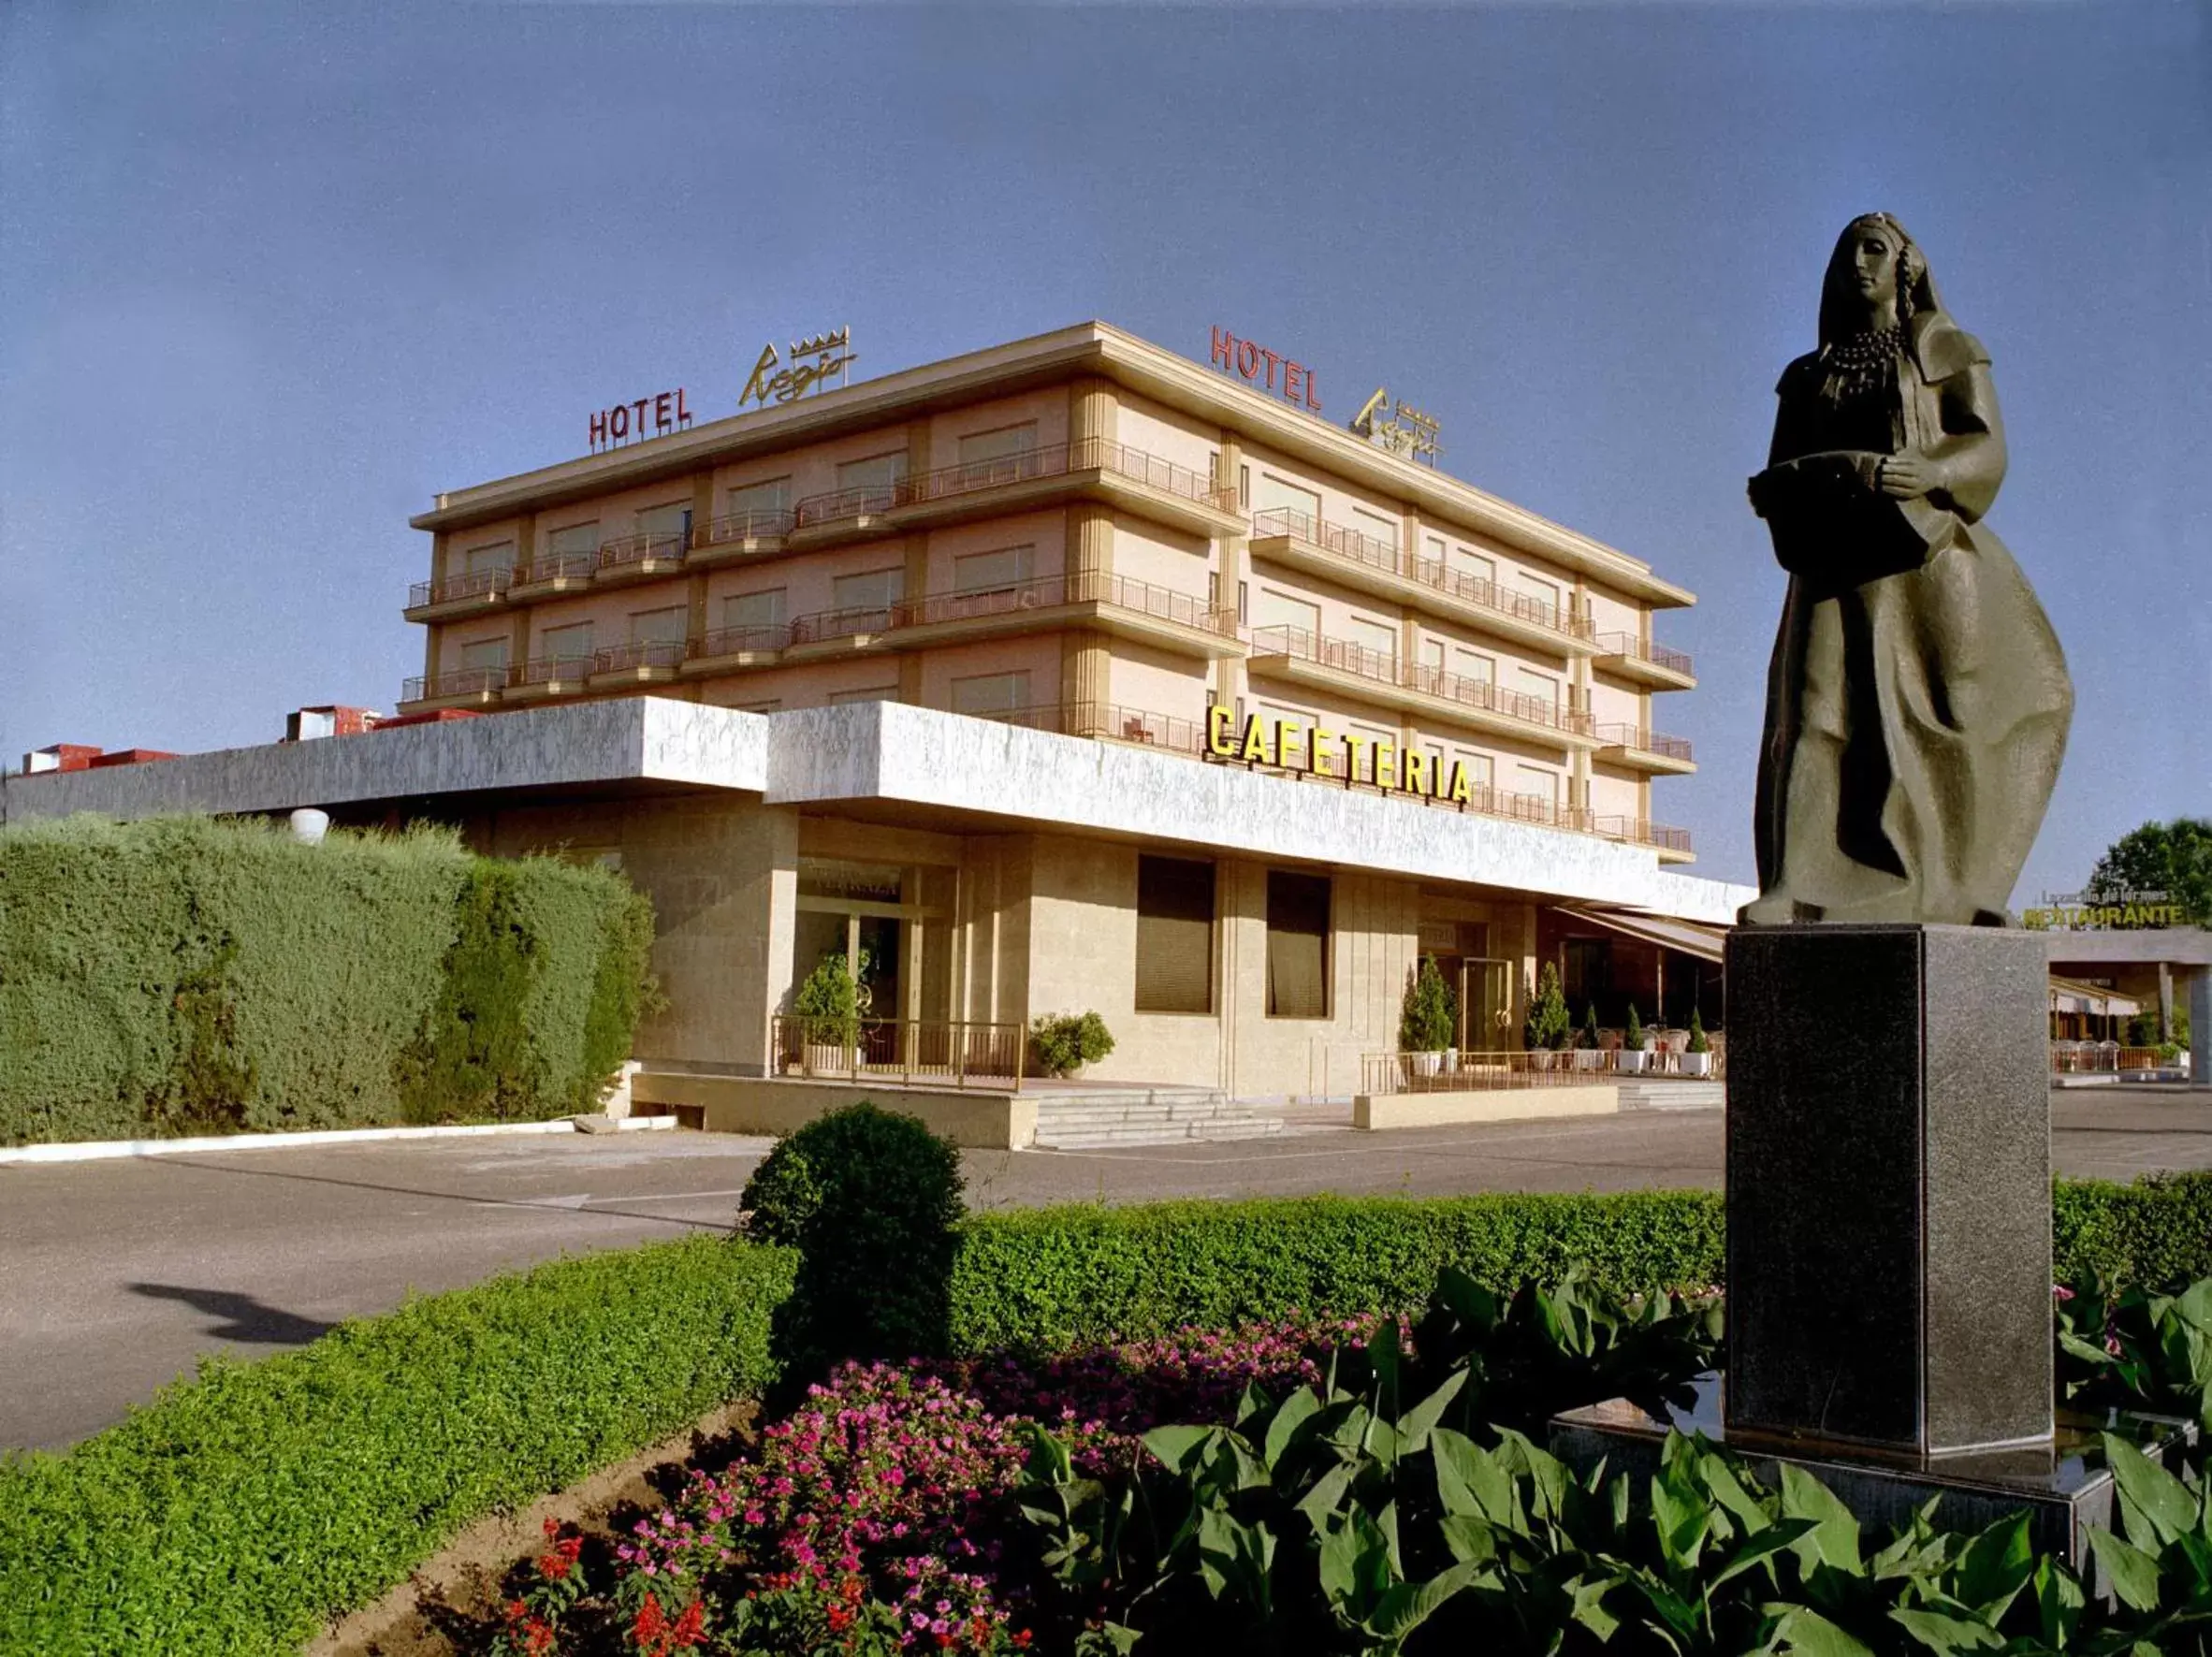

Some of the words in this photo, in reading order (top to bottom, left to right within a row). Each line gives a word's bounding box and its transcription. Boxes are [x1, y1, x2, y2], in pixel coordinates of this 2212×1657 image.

[1211, 325, 1322, 410] HOTEL
[589, 387, 693, 446] HOTEL
[1206, 705, 1473, 803] CAFETERIA
